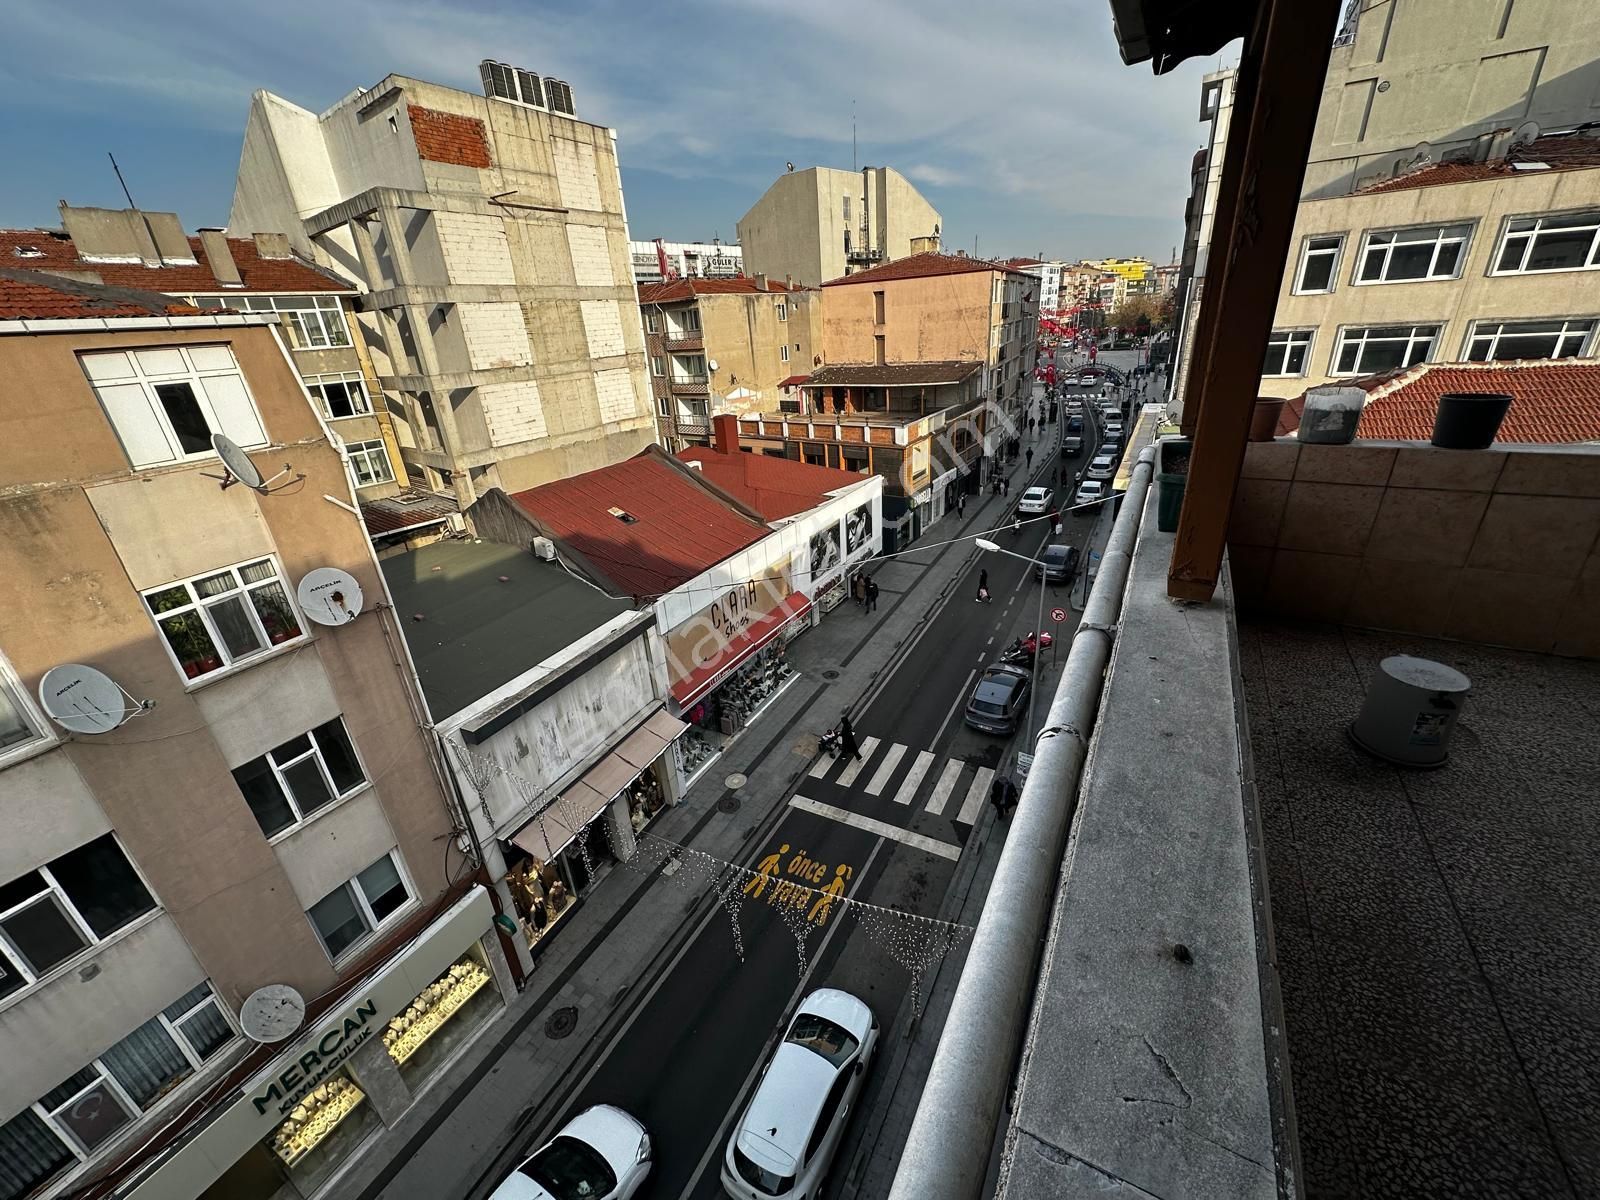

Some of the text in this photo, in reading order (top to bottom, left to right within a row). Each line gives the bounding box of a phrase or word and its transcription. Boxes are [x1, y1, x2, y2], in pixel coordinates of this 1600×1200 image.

[710, 579, 757, 629] CLARA
[787, 849, 827, 883] önce
[251, 998, 377, 1116] MERCAN
[278, 1026, 372, 1115] KUYUMCULUK
